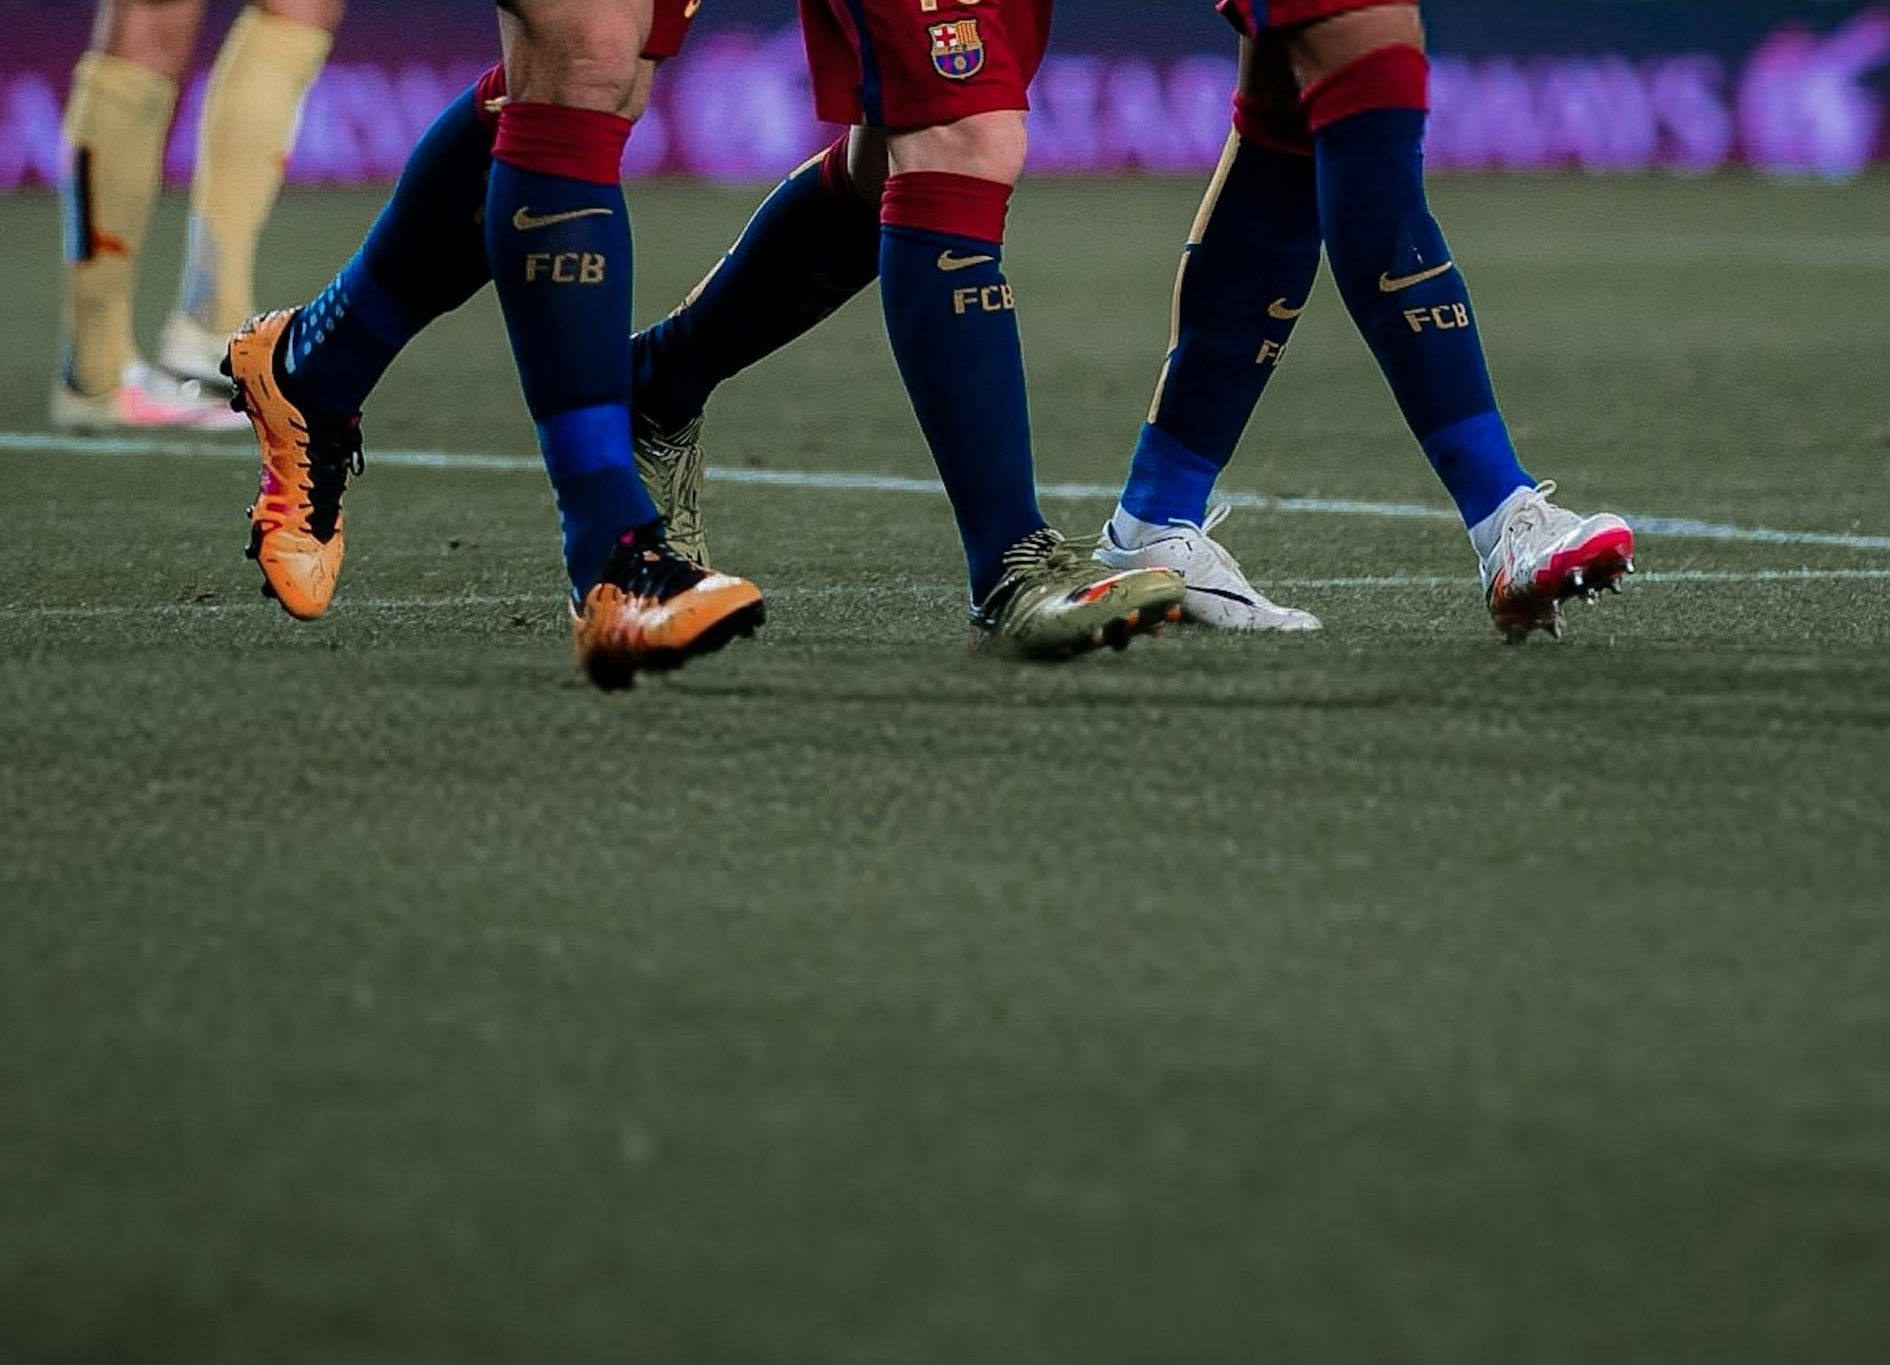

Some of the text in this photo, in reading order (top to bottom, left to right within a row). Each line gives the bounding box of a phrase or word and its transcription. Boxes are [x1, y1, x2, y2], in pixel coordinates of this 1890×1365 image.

[526, 252, 606, 283] FCB
[953, 283, 1016, 315] FCB
[1403, 303, 1470, 333] FCB
